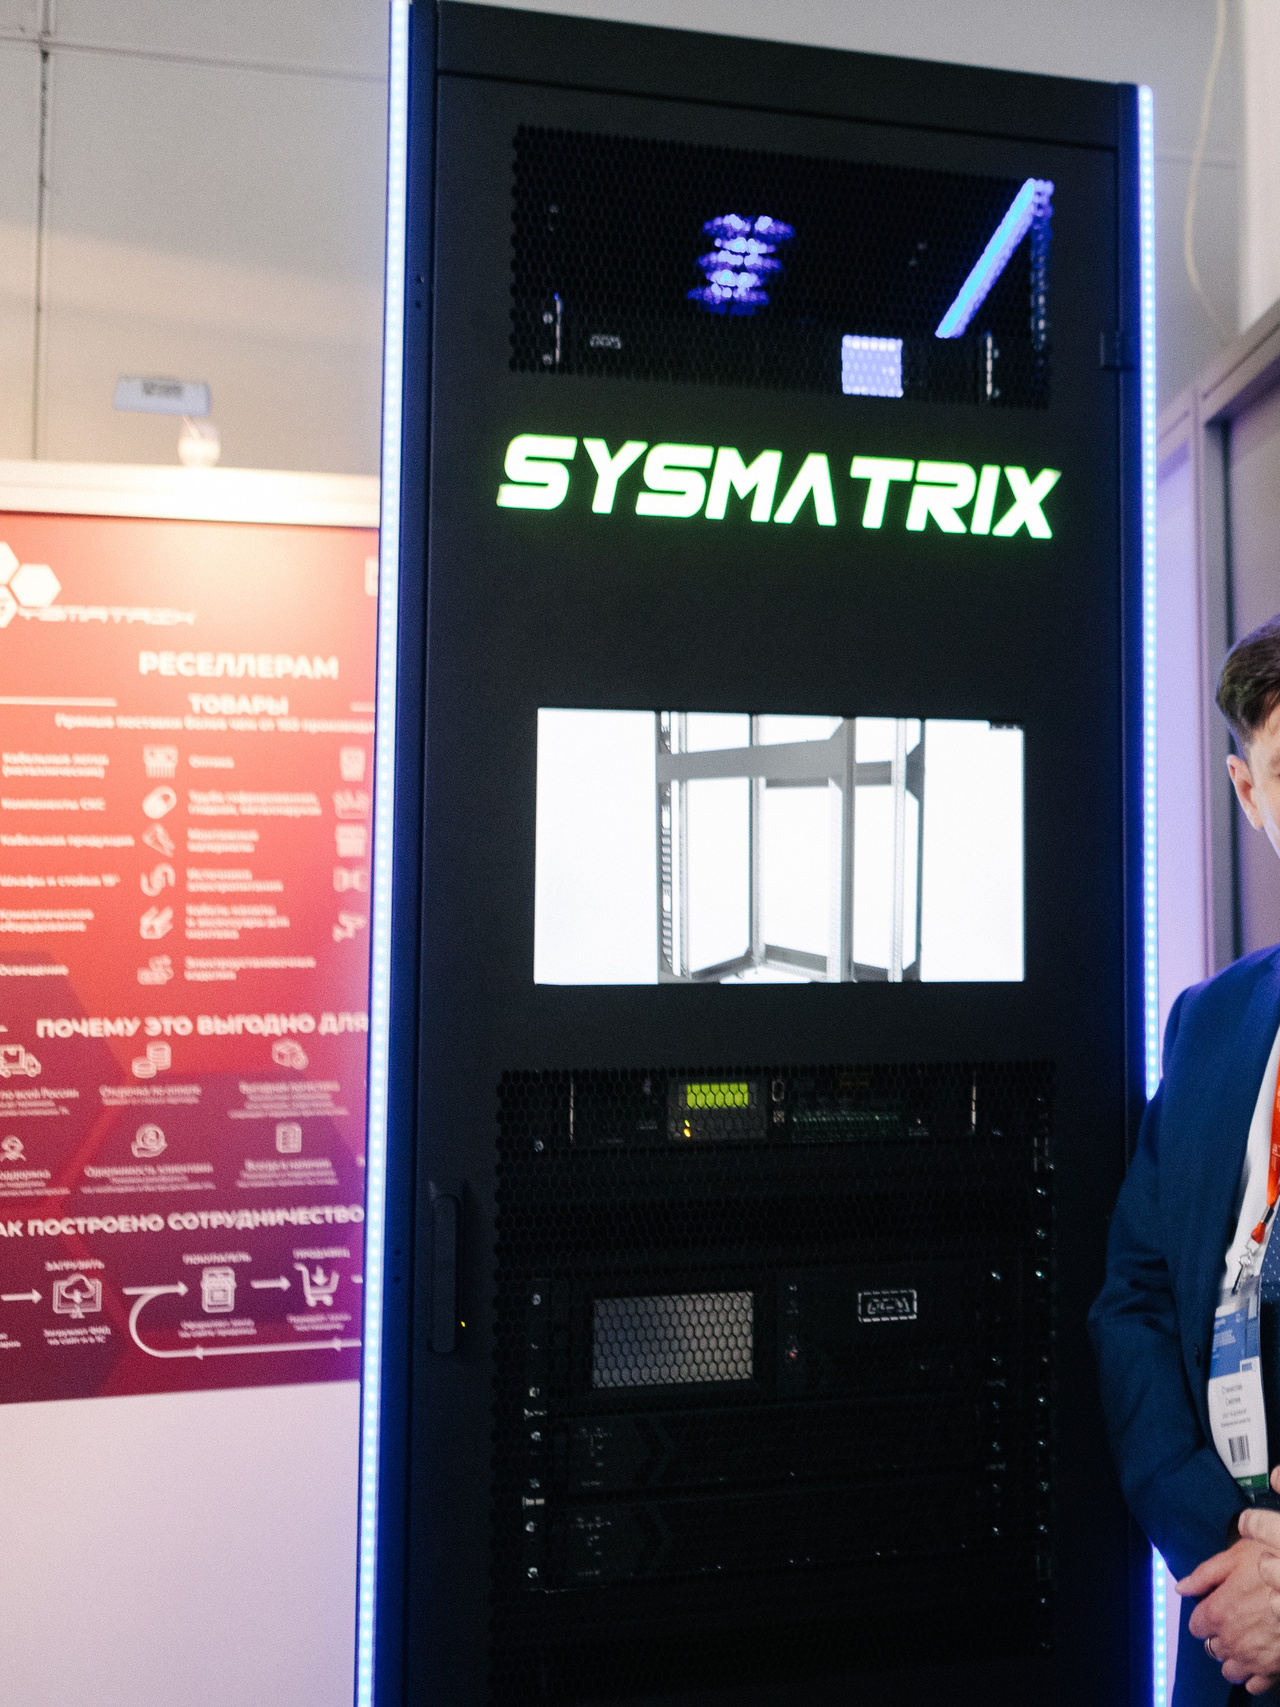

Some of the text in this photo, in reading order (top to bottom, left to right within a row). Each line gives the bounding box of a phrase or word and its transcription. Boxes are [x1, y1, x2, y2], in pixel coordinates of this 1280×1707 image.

[497, 434, 1062, 540] SYSMATRIX
[138, 649, 339, 681] РЕСЕЛЛЕРАМ
[187, 691, 290, 716] ТОВАРЫ
[36, 1016, 142, 1039] ПОЧЕМУ
[144, 1016, 194, 1037] ЭТО
[197, 1012, 316, 1037] ВЫГОДНО
[27, 1213, 165, 1238] ПОСТРОЕНО
[166, 1204, 365, 1231] СОТРУДНИЧЕСТВО
